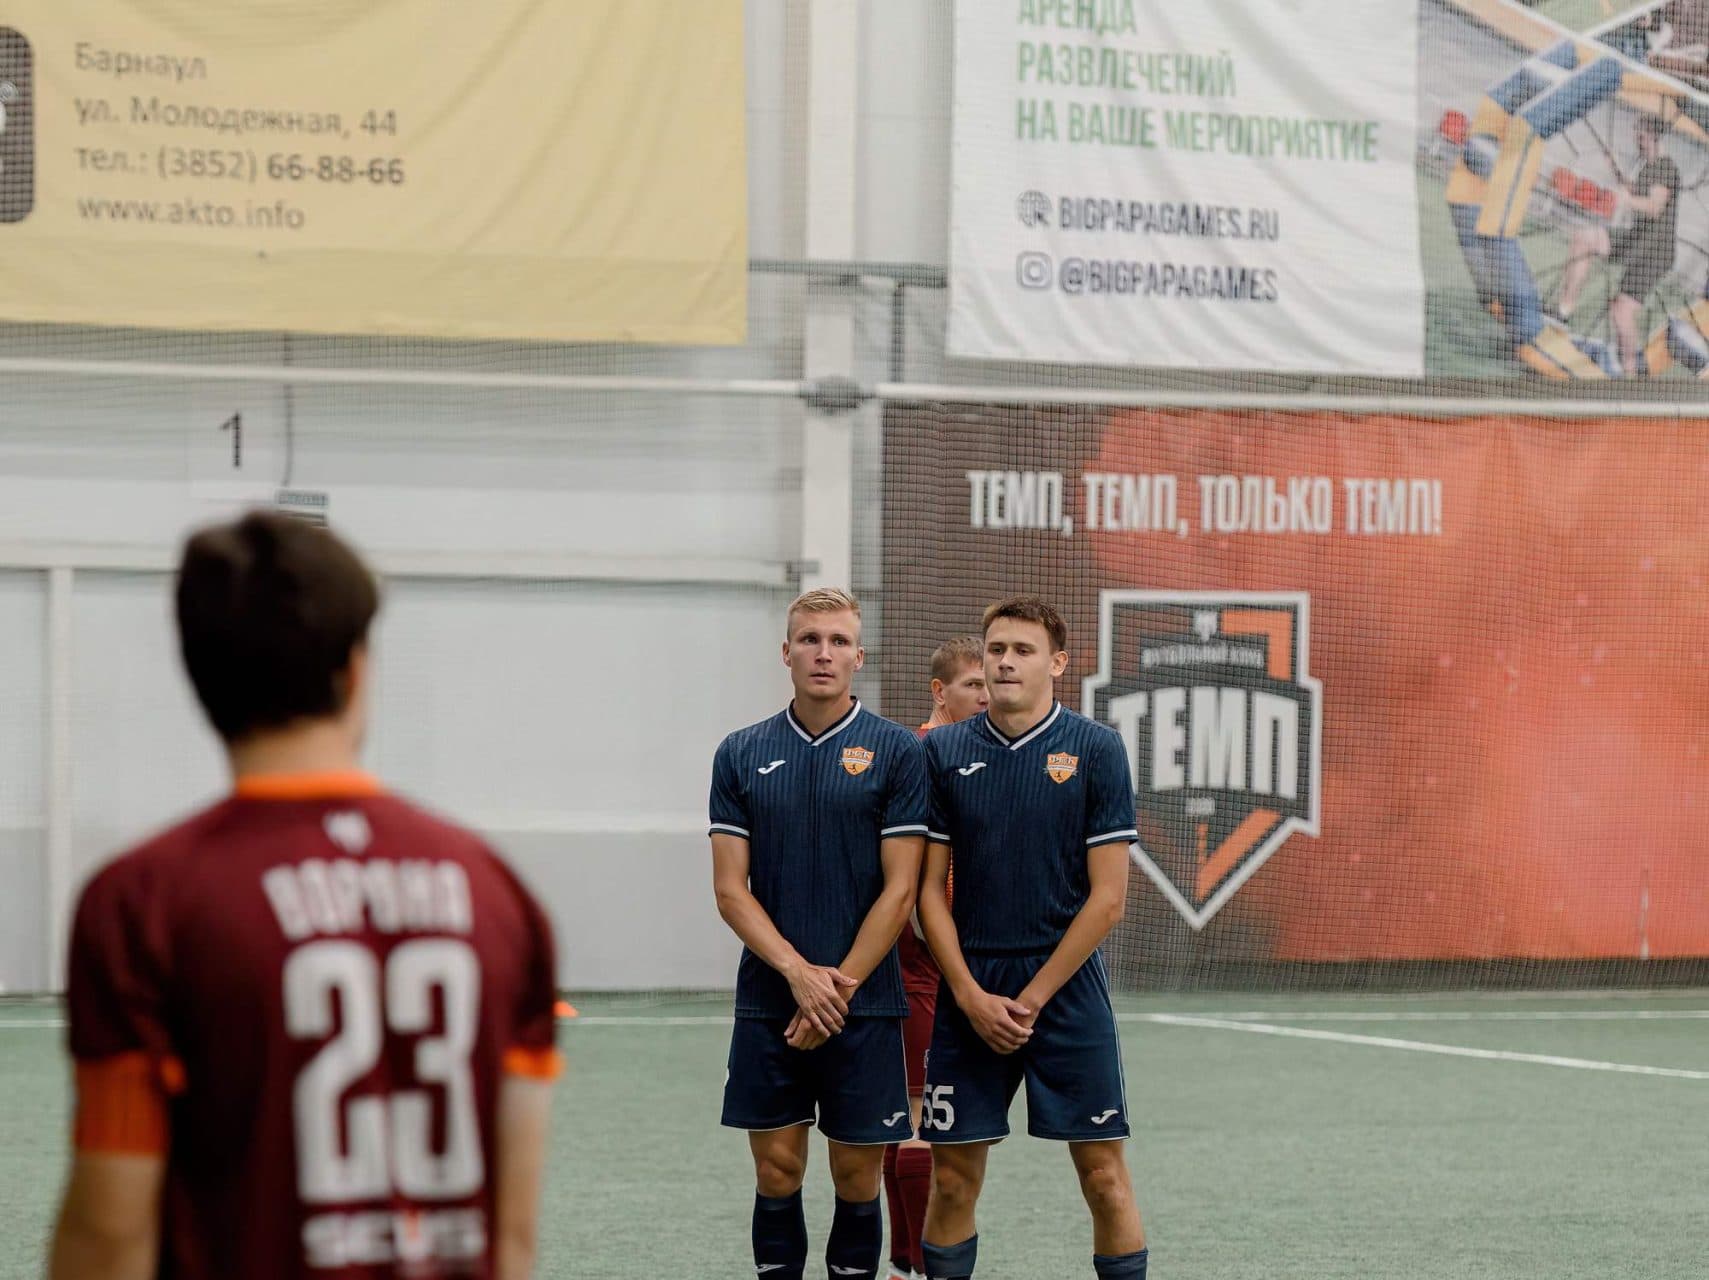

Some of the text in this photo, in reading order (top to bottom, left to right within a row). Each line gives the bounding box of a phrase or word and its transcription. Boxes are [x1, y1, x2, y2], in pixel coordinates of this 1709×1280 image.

[75, 41, 208, 81] Барнаул
[1018, 41, 1236, 97] РАЗВЛЕЧЕНИЙ
[74, 96, 398, 140] ул. Молодежная, 44
[1016, 98, 1381, 163] НА ВАШЕ МЕРОПРИЯТИЕ
[75, 145, 405, 185] тел.: (3852) 66-88-66
[77, 198, 306, 230] www.akto.info
[1059, 197, 1281, 242] BIGPAPAGAMES.RU
[1059, 257, 1280, 302] @BIGPAPAGAMES
[218, 412, 241, 468] 1
[967, 470, 1443, 537] ТЕМП, ТЕМП, ТОЛЬКО ТЕМП!
[1109, 685, 1299, 800] ТЕМП
[283, 937, 485, 1203] 23
